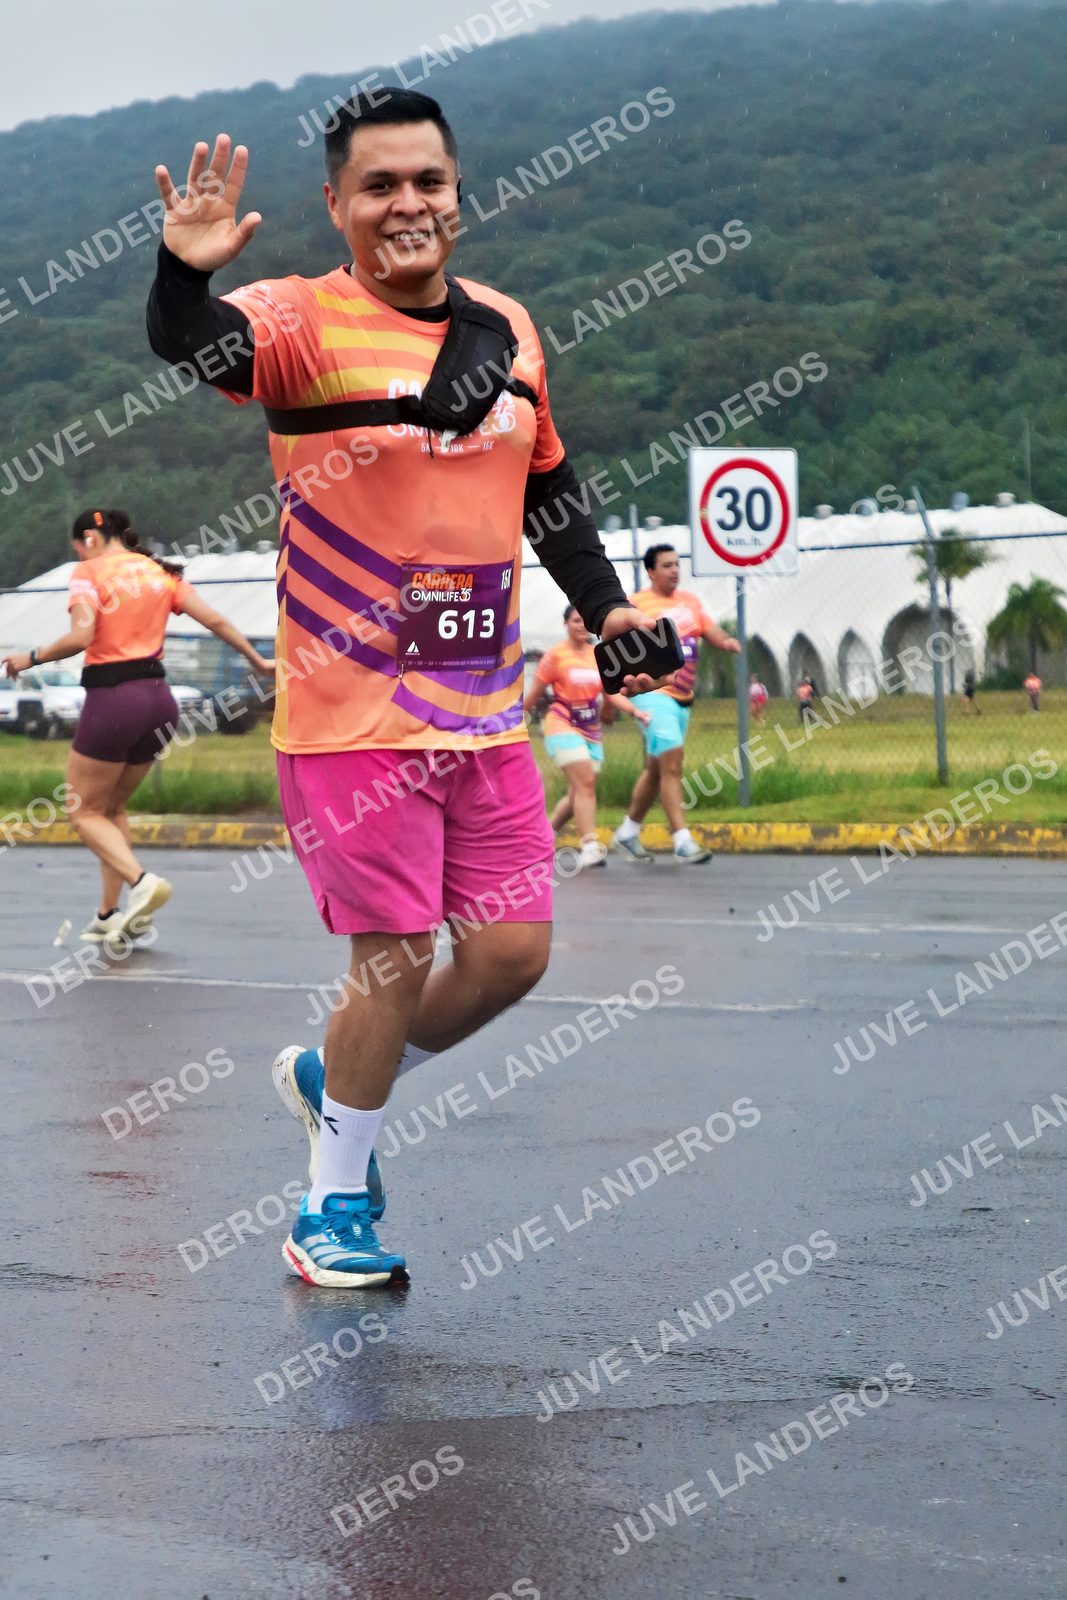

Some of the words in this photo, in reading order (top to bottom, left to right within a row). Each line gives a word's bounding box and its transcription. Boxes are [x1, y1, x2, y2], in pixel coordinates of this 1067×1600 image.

[716, 486, 772, 532] 30
[412, 572, 474, 590] CARRERA
[438, 609, 495, 639] 613
